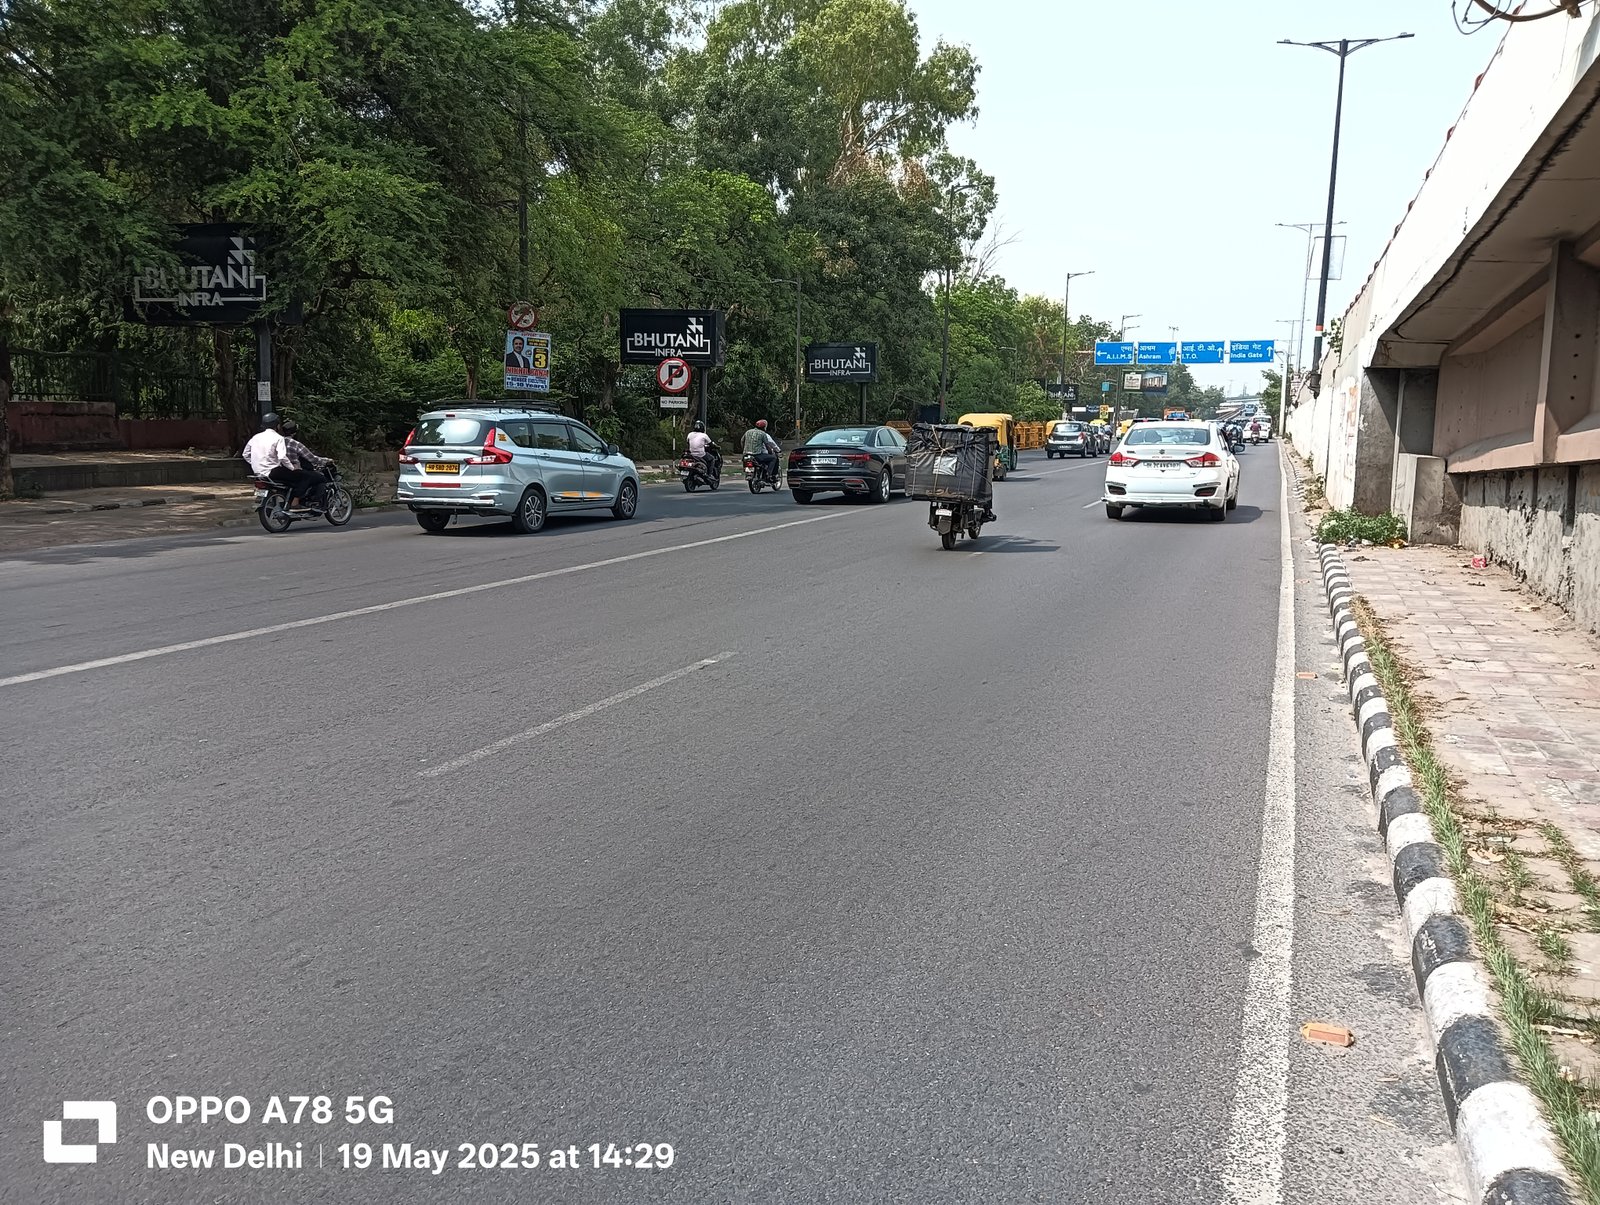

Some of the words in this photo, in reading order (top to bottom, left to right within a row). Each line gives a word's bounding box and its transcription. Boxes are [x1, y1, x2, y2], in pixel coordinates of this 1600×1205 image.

[178, 291, 224, 306] INFRA
[634, 333, 703, 347] BHUTANI
[655, 348, 683, 357] INFRA
[1231, 343, 1249, 351] इंडिया
[535, 353, 546, 368] 3
[814, 359, 866, 368] BHUTANI
